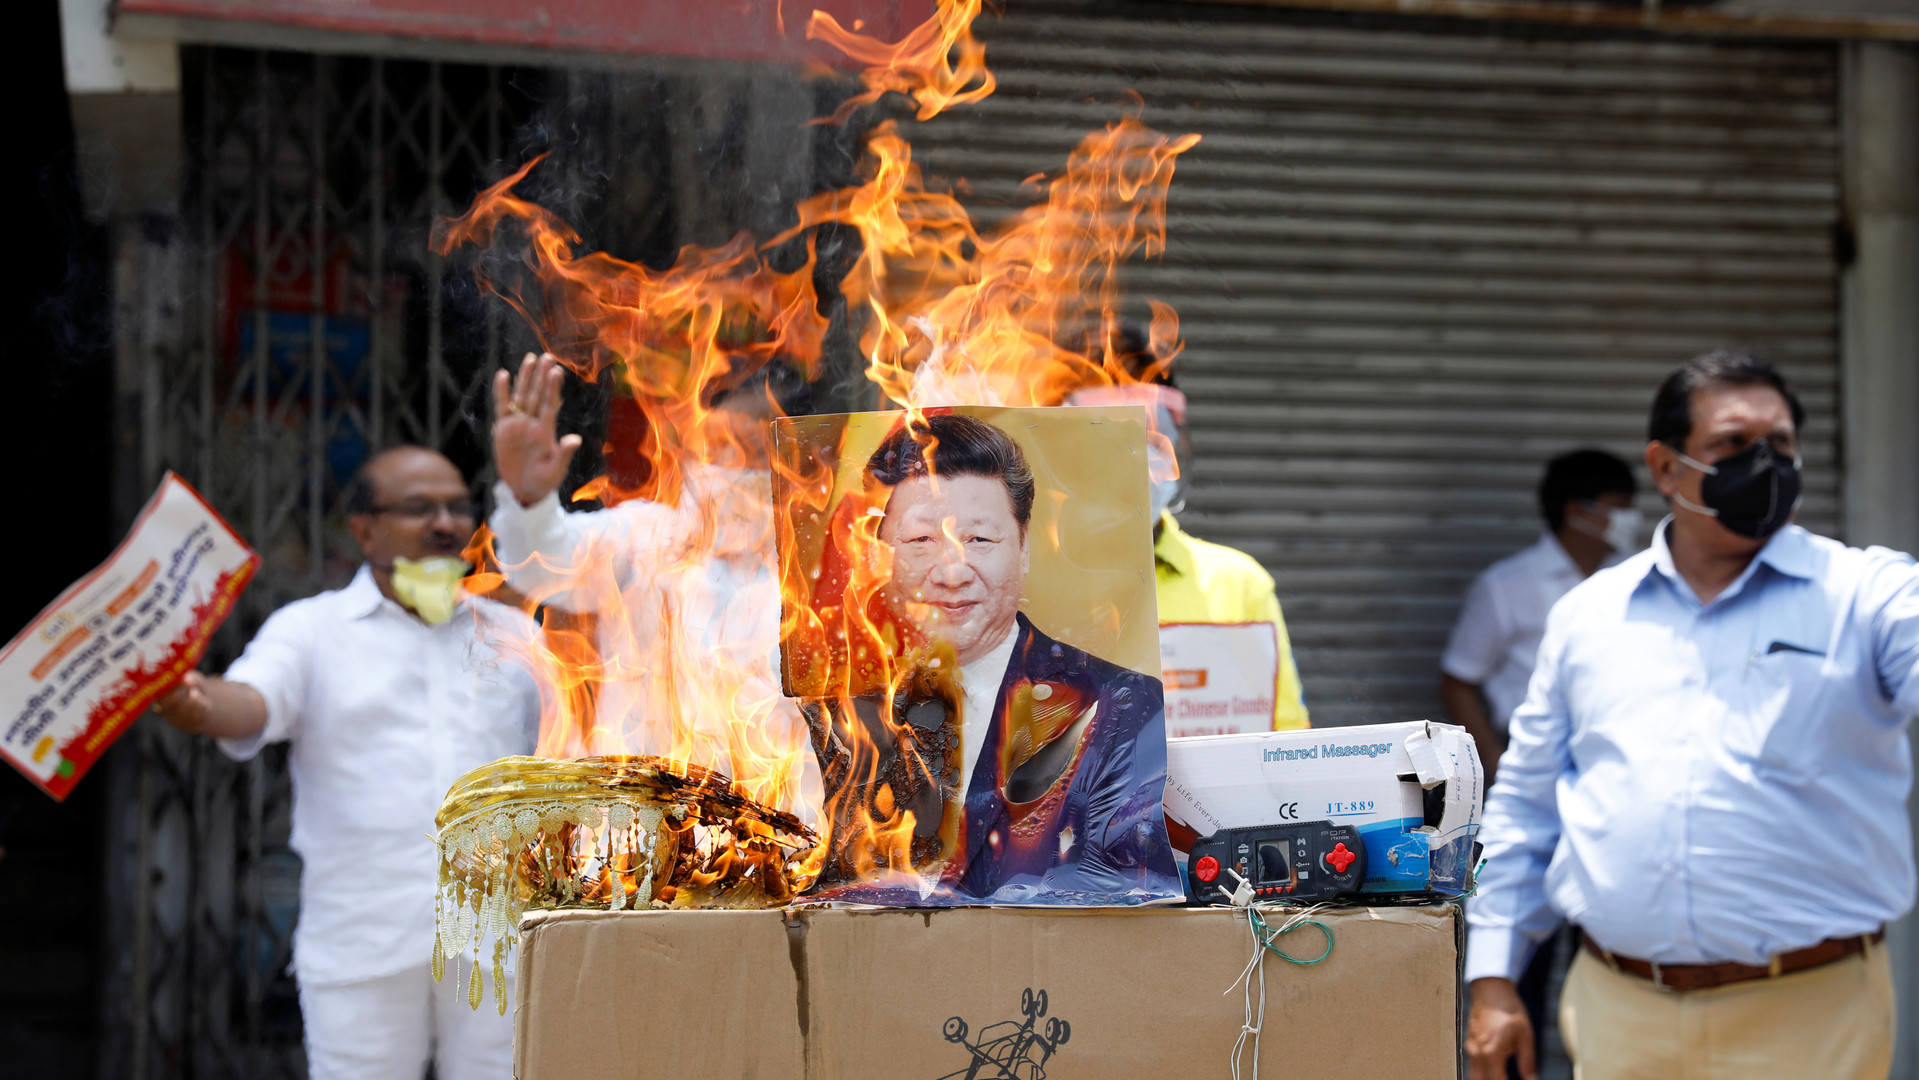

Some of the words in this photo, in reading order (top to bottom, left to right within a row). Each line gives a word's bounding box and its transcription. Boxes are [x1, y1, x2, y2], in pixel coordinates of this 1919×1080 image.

[1178, 698, 1228, 719] Chinese
[1263, 745, 1318, 762] Infrared
[1321, 743, 1393, 758] Massager
[1176, 785, 1193, 803] Life
[1193, 801, 1224, 830] Everyda
[1326, 800, 1374, 814] JT-889
[1333, 873, 1352, 881] ROTATE
